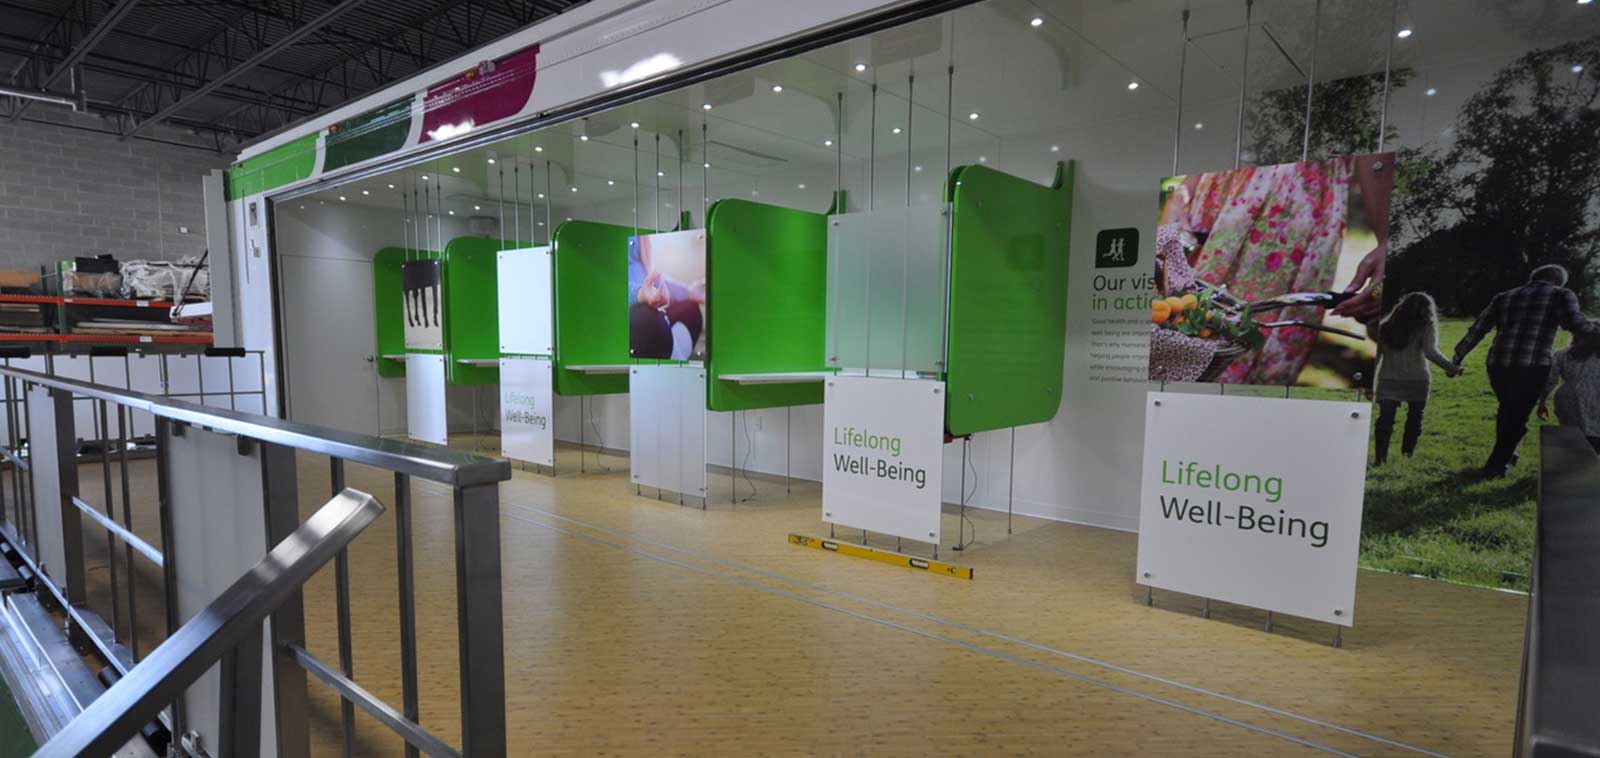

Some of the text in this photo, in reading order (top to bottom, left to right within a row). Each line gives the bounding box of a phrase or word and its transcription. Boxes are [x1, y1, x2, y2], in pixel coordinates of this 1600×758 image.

[1093, 275, 1127, 291] Our
[1092, 294, 1108, 311] in
[505, 392, 535, 410] Lifelong
[505, 408, 546, 430] Well-Being
[834, 426, 901, 457] Lifelong
[834, 453, 926, 489] Well-Being
[1162, 460, 1283, 503] Lifelong
[1160, 495, 1329, 548] Well-Being
